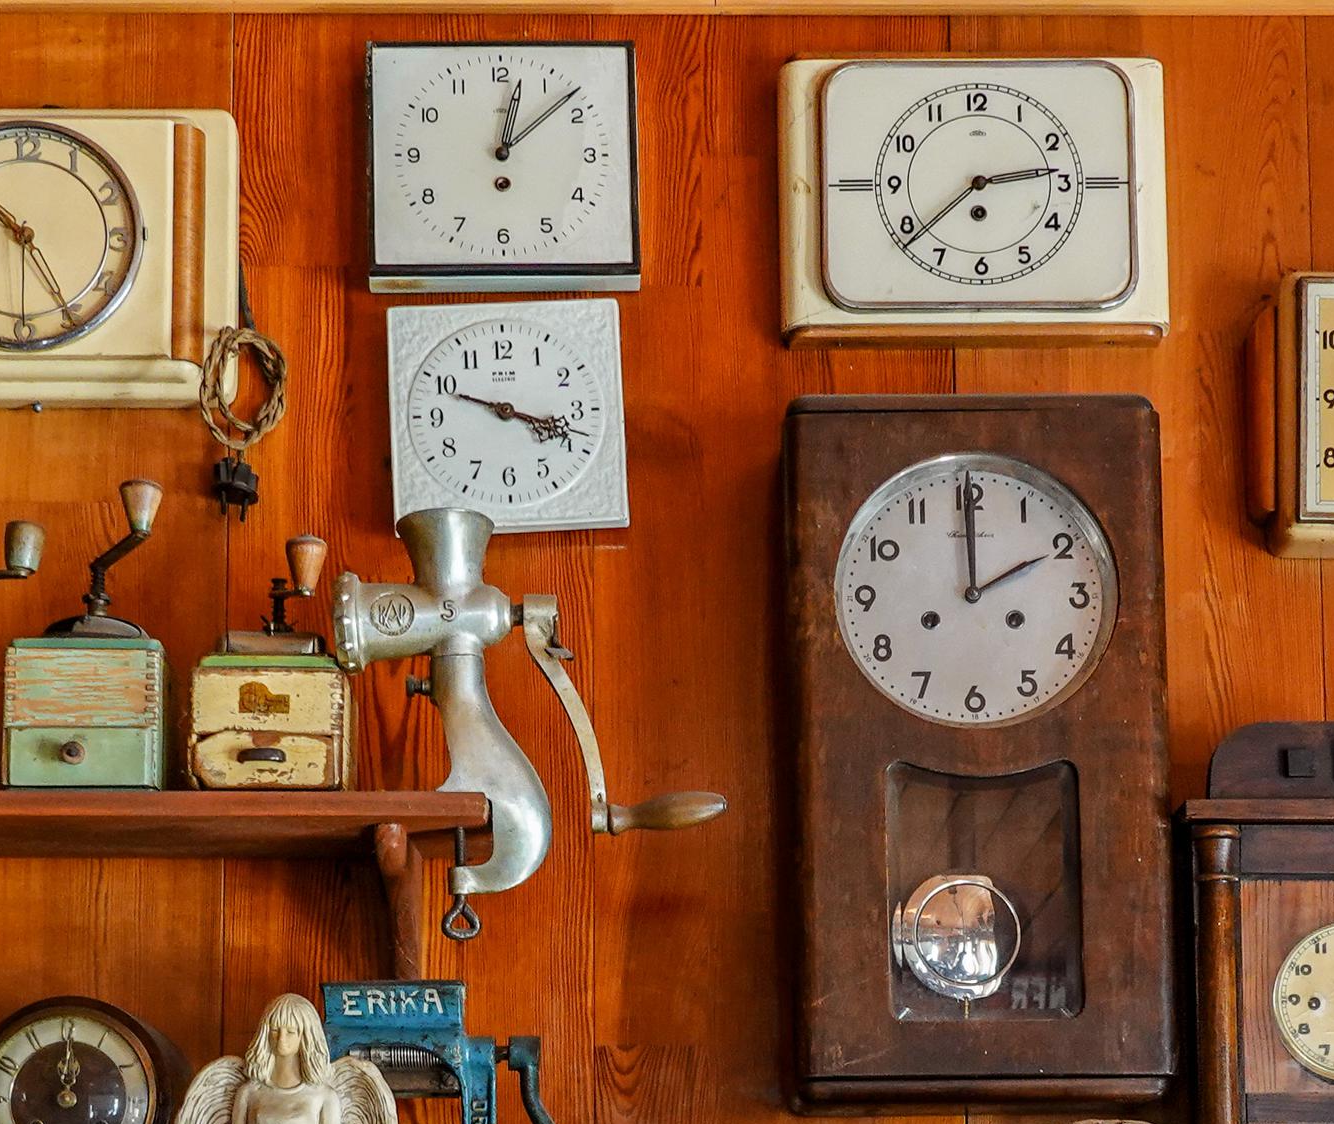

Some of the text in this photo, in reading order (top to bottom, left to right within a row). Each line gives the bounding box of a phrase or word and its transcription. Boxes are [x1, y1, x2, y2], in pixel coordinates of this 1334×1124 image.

[492, 67, 509, 83] 12
[452, 79, 465, 94] 11
[966, 93, 988, 112] 12
[421, 107, 438, 123] 10
[571, 108, 584, 124] 2
[928, 104, 942, 122] 11
[896, 134, 914, 153] 10
[1045, 133, 1059, 150] 2
[407, 148, 420, 163] 9
[584, 148, 596, 163] 3
[887, 175, 902, 194] 9
[900, 216, 914, 234] 8
[1044, 213, 1061, 231] 4
[497, 229, 510, 244] 6
[975, 257, 989, 275] 6
[492, 340, 513, 360] 12
[462, 350, 478, 370] 11
[436, 375, 457, 395] 10
[557, 368, 570, 387] 2
[430, 407, 444, 428] 9
[442, 437, 456, 457] 8
[470, 460, 482, 480] 7
[503, 467, 516, 487] 6
[908, 497, 925, 524] 11
[870, 535, 900, 562] 10
[1052, 533, 1074, 559] 2
[855, 585, 876, 612] 9
[1069, 582, 1090, 609] 3
[440, 600, 457, 622] 5
[873, 634, 892, 662] 8
[964, 685, 986, 713] 6
[1295, 964, 1312, 975] 10
[342, 988, 444, 1017] ERIKA
